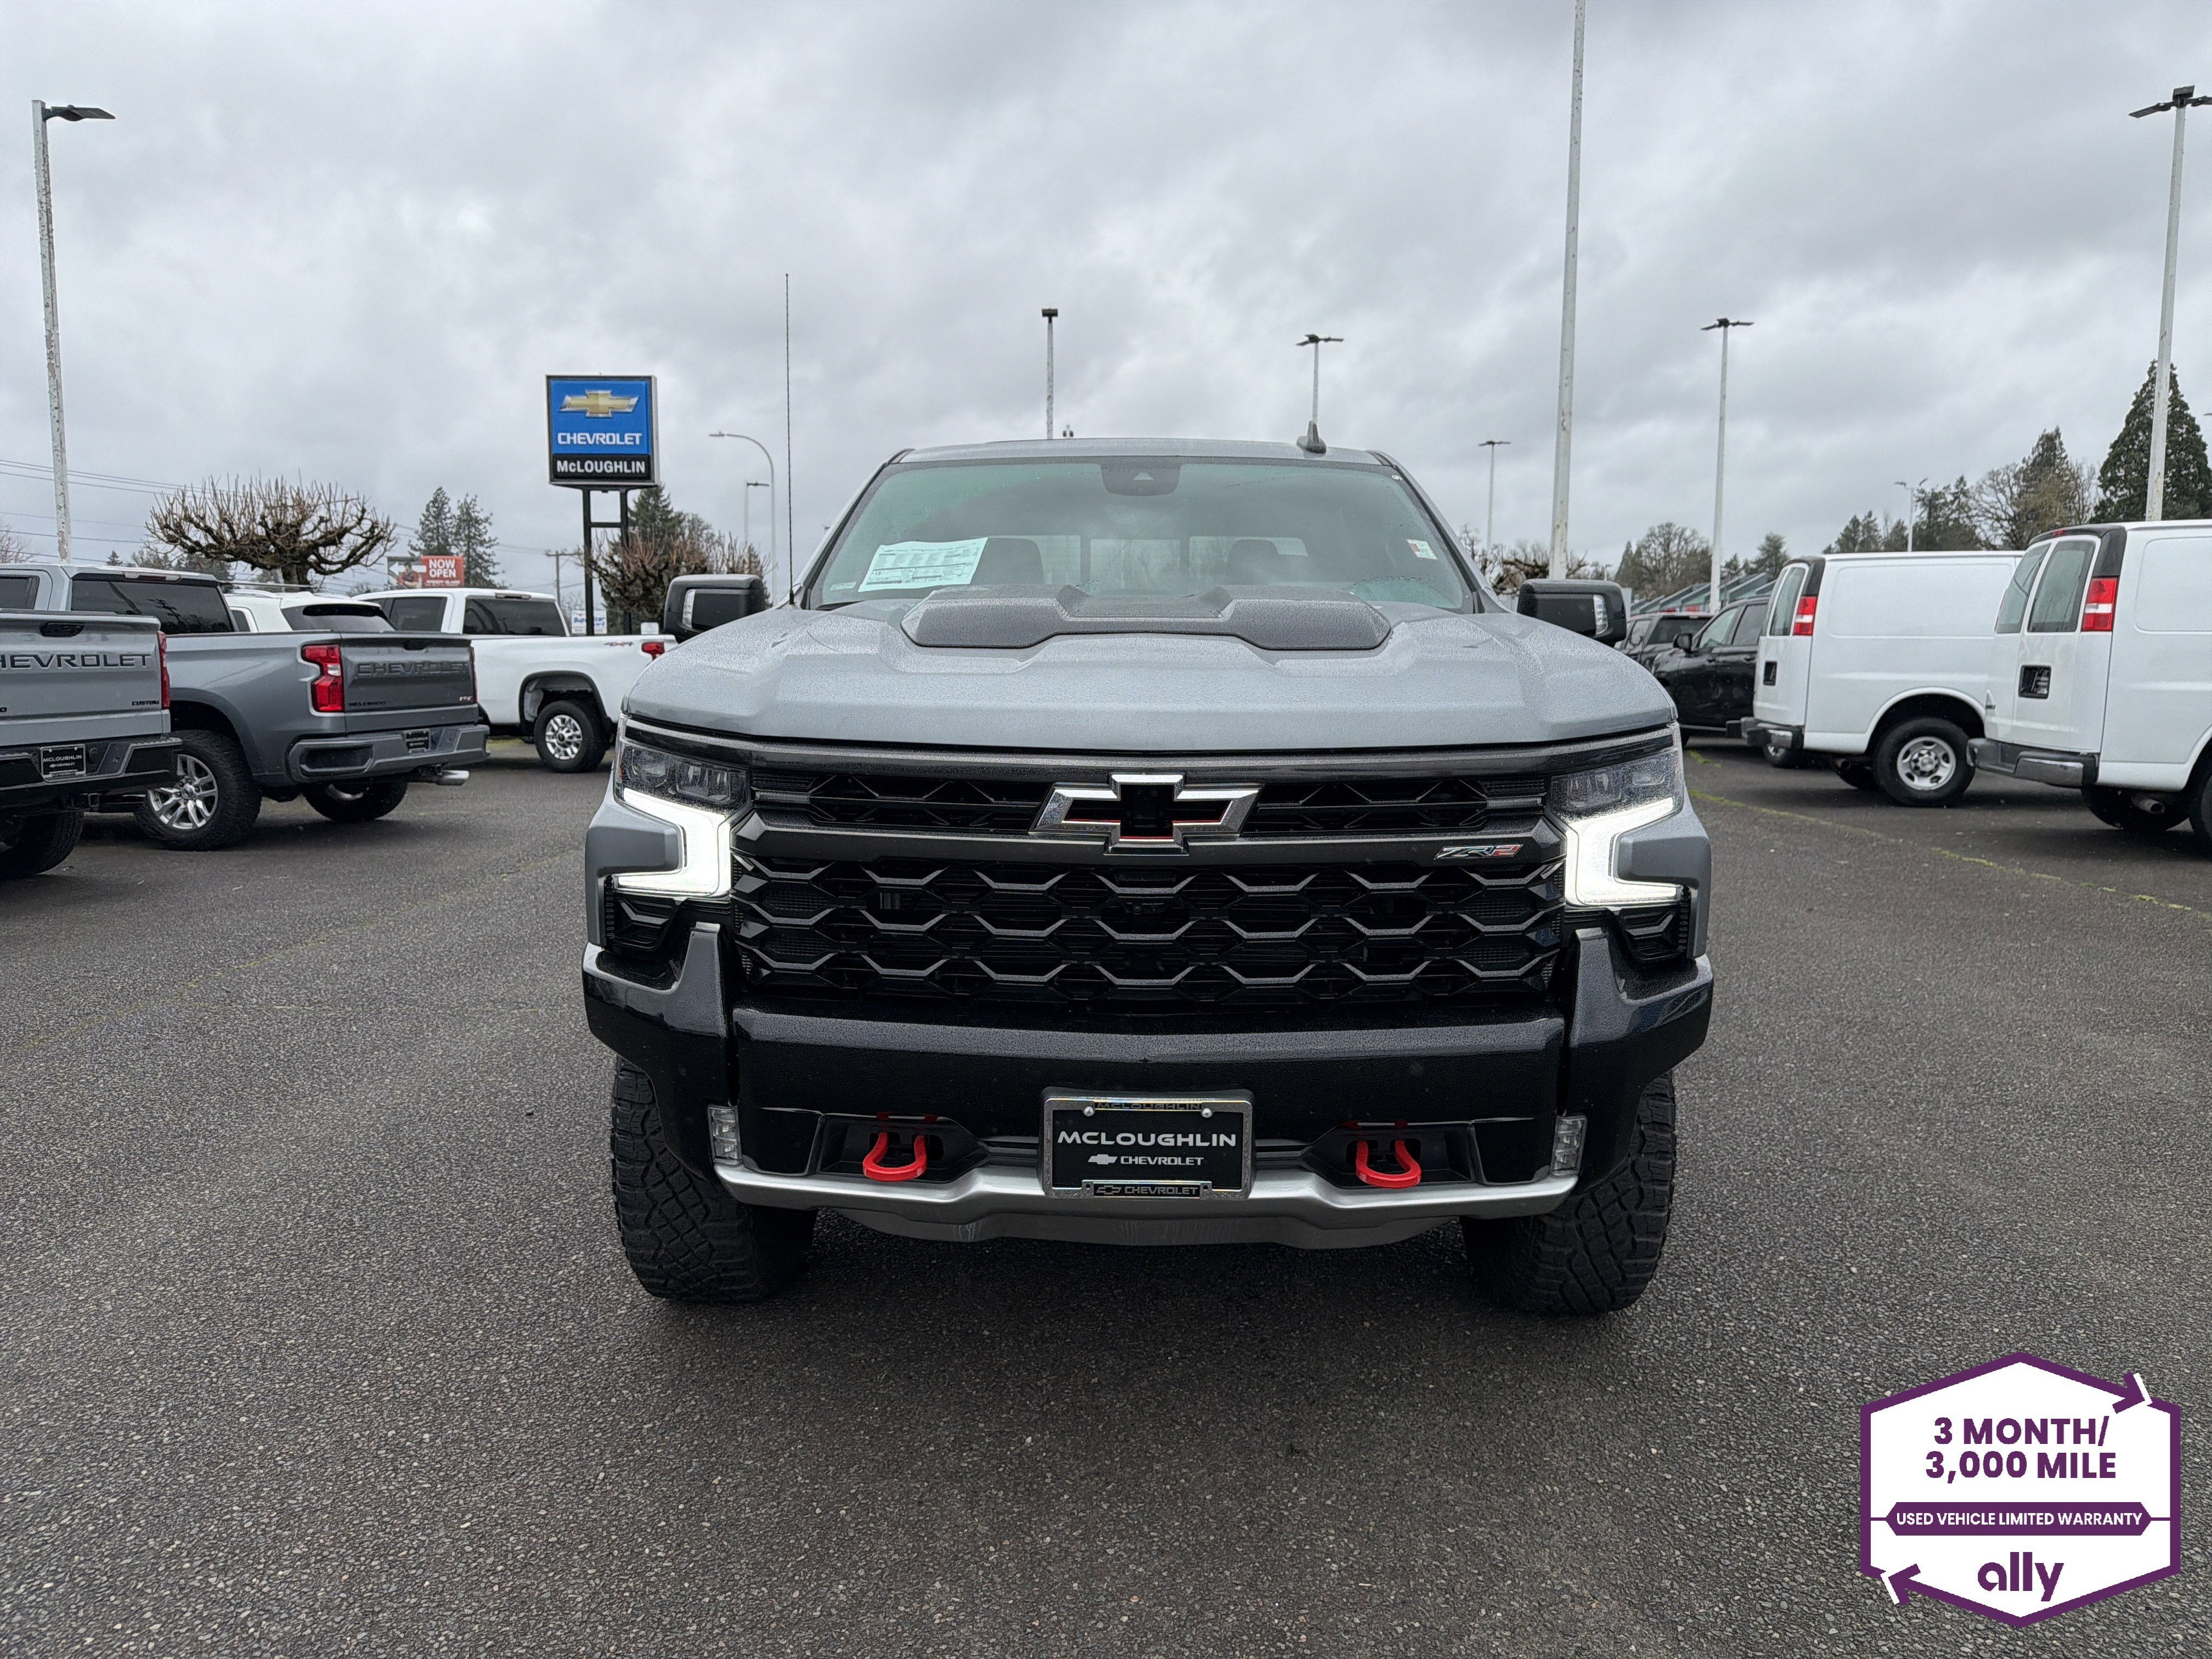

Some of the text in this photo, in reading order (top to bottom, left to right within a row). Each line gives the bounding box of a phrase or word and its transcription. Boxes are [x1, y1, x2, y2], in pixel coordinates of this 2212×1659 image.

[557, 432, 642, 445] CHEVROLET
[556, 460, 645, 473] McLOUGHLIN
[428, 558, 455, 569] NOW
[429, 568, 456, 578] OPEN
[357, 661, 471, 675] CHEVROLET
[1434, 844, 1523, 860] ZR2
[1057, 1131, 1236, 1147] MCLOUGHLIN
[1120, 1156, 1204, 1165] CHEVROLET
[1124, 1186, 1199, 1195] CHEVROLET
